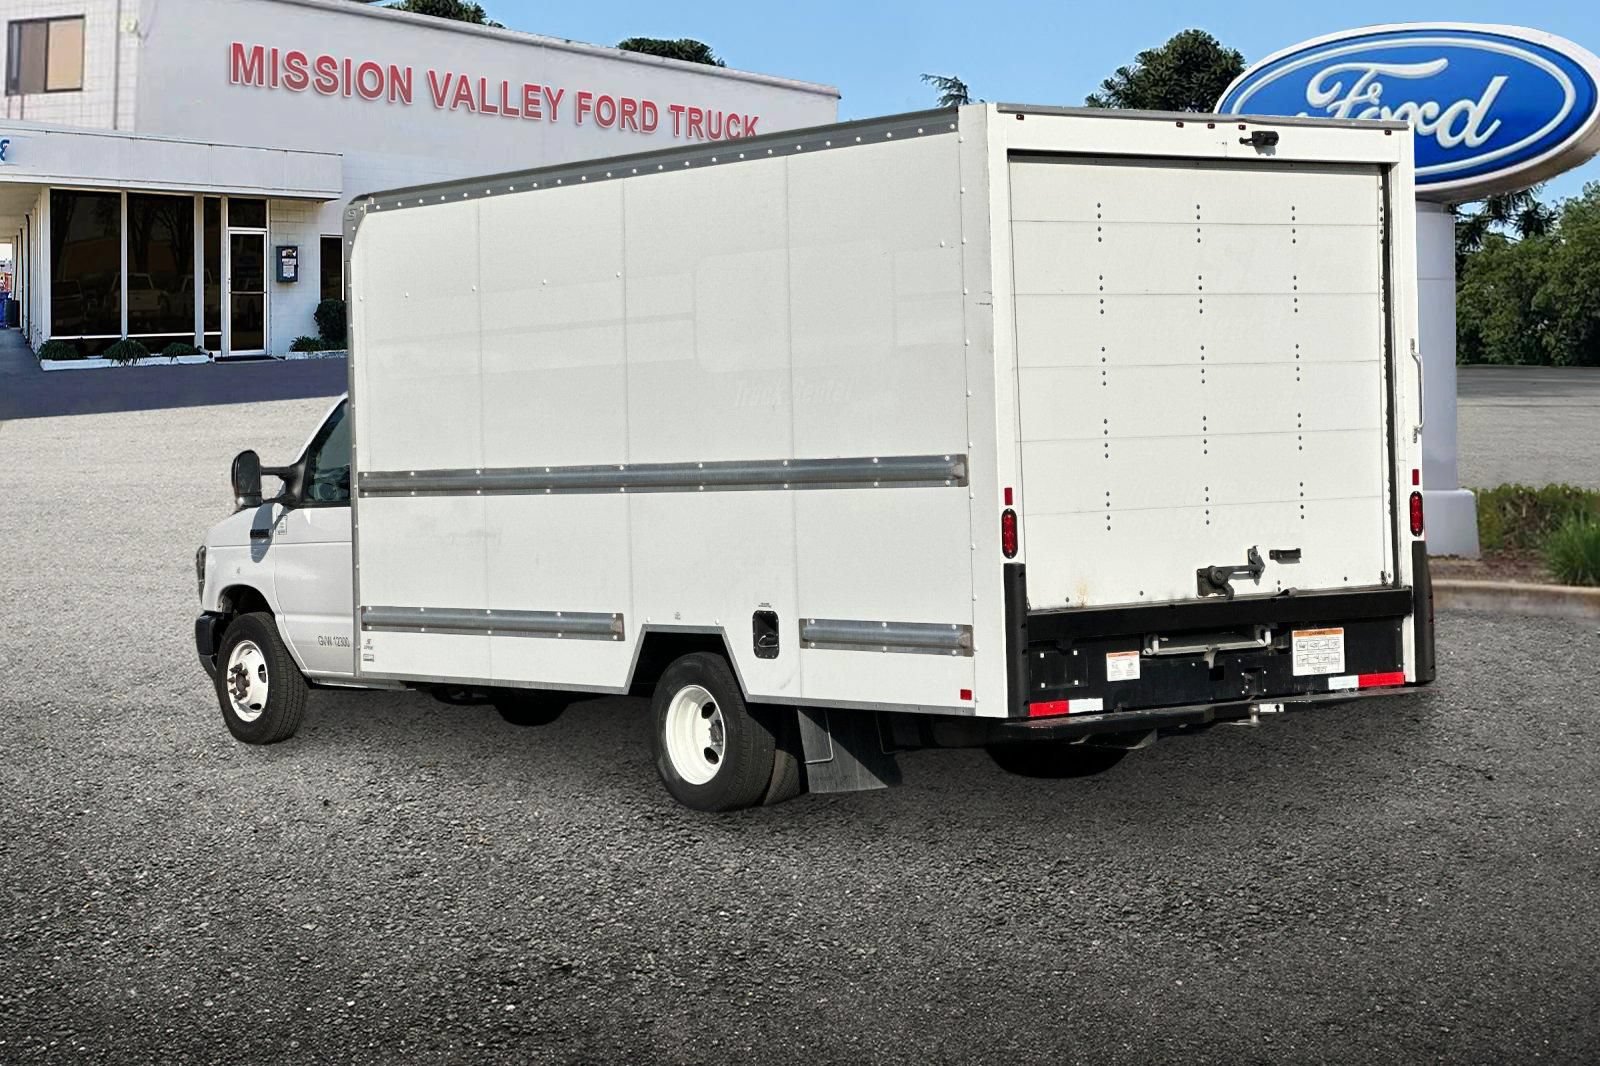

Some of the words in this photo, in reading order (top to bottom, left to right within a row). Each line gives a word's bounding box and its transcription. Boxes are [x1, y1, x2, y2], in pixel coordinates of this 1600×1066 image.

[230, 41, 414, 105] MISSION
[427, 69, 565, 122] VALLEY
[575, 91, 659, 134] FORD
[668, 103, 760, 141] TRUCK
